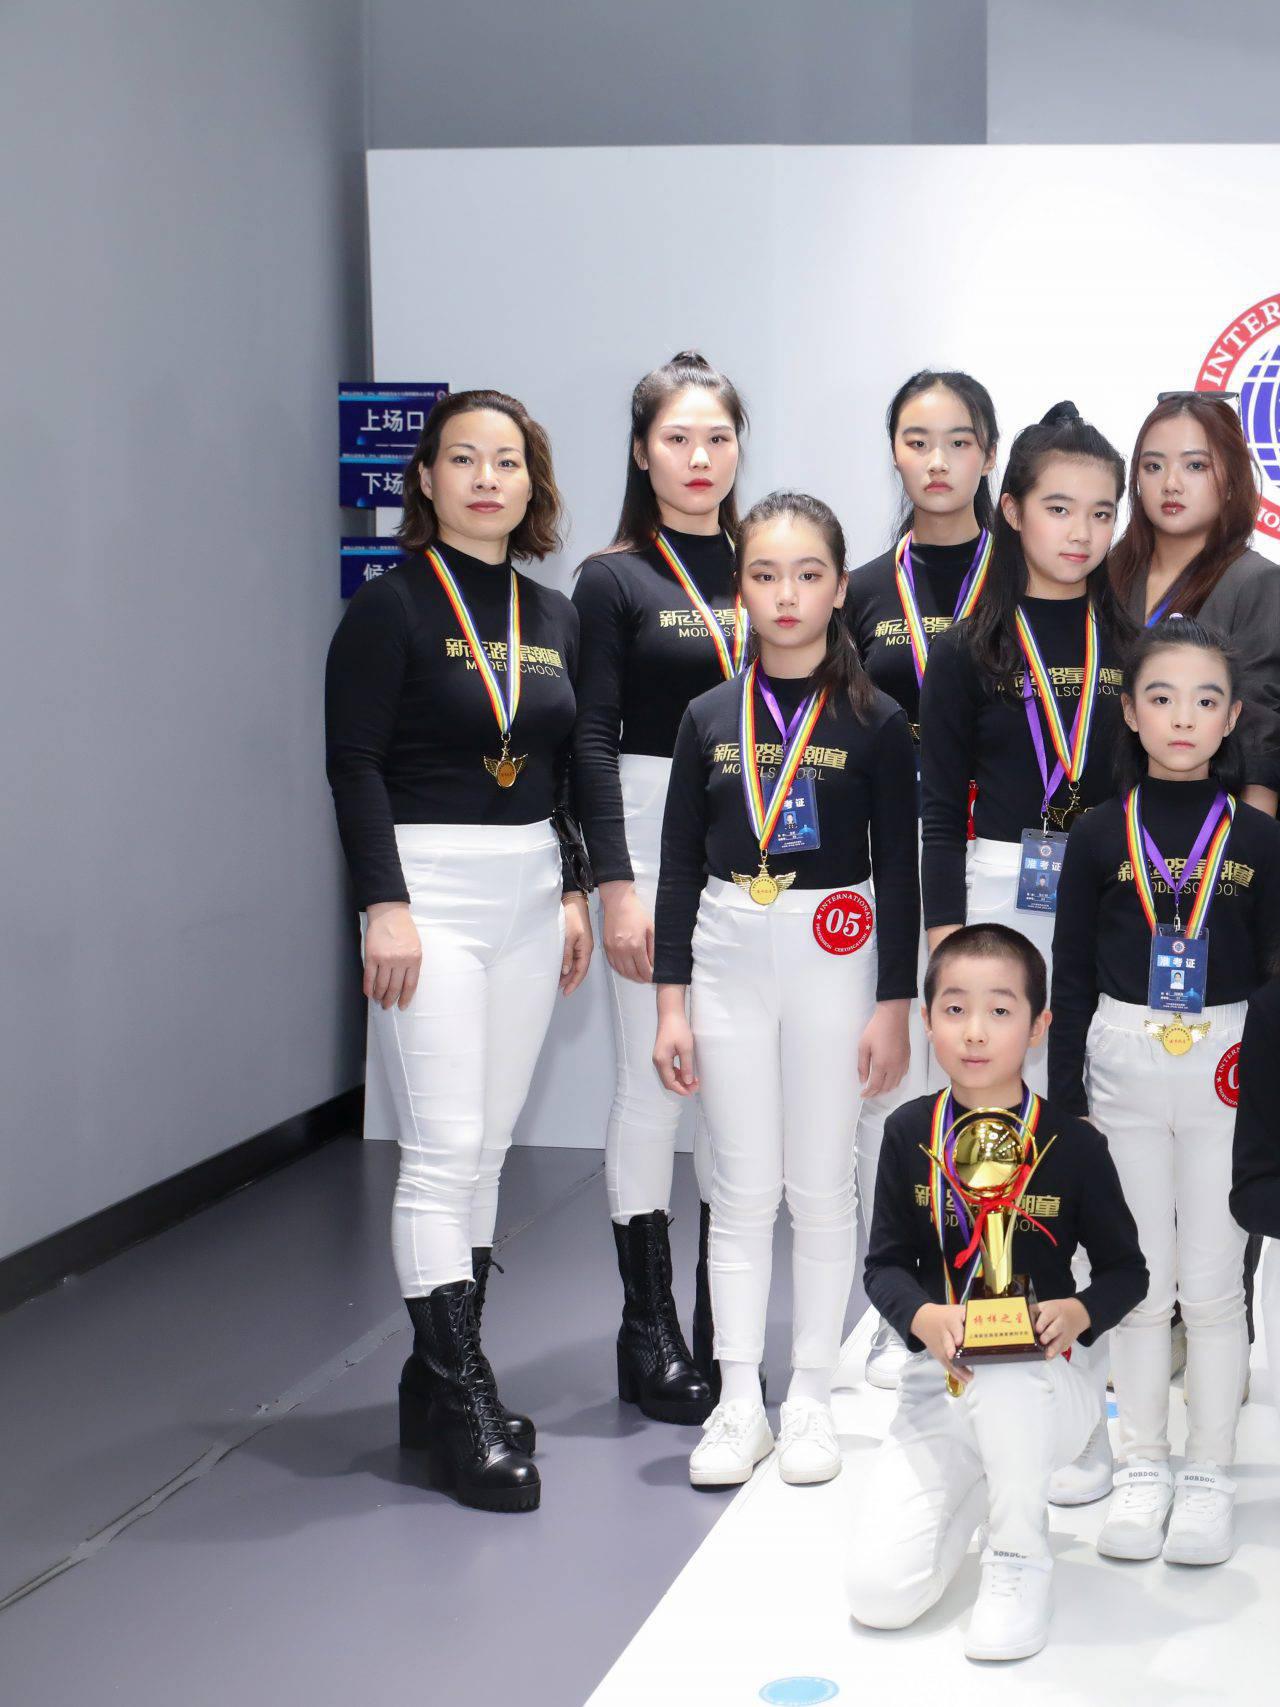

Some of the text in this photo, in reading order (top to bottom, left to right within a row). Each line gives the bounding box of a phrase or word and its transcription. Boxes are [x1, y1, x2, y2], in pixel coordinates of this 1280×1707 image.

[360, 408, 425, 433] 上场口
[361, 472, 404, 495] 下场
[362, 563, 398, 583] 候
[466, 659, 560, 678] MDELCHOOL
[713, 743, 849, 770] 新路潮童
[722, 763, 825, 781] MOLSOOL
[819, 893, 872, 922] INTERNATIONAL
[825, 908, 862, 937] 05
